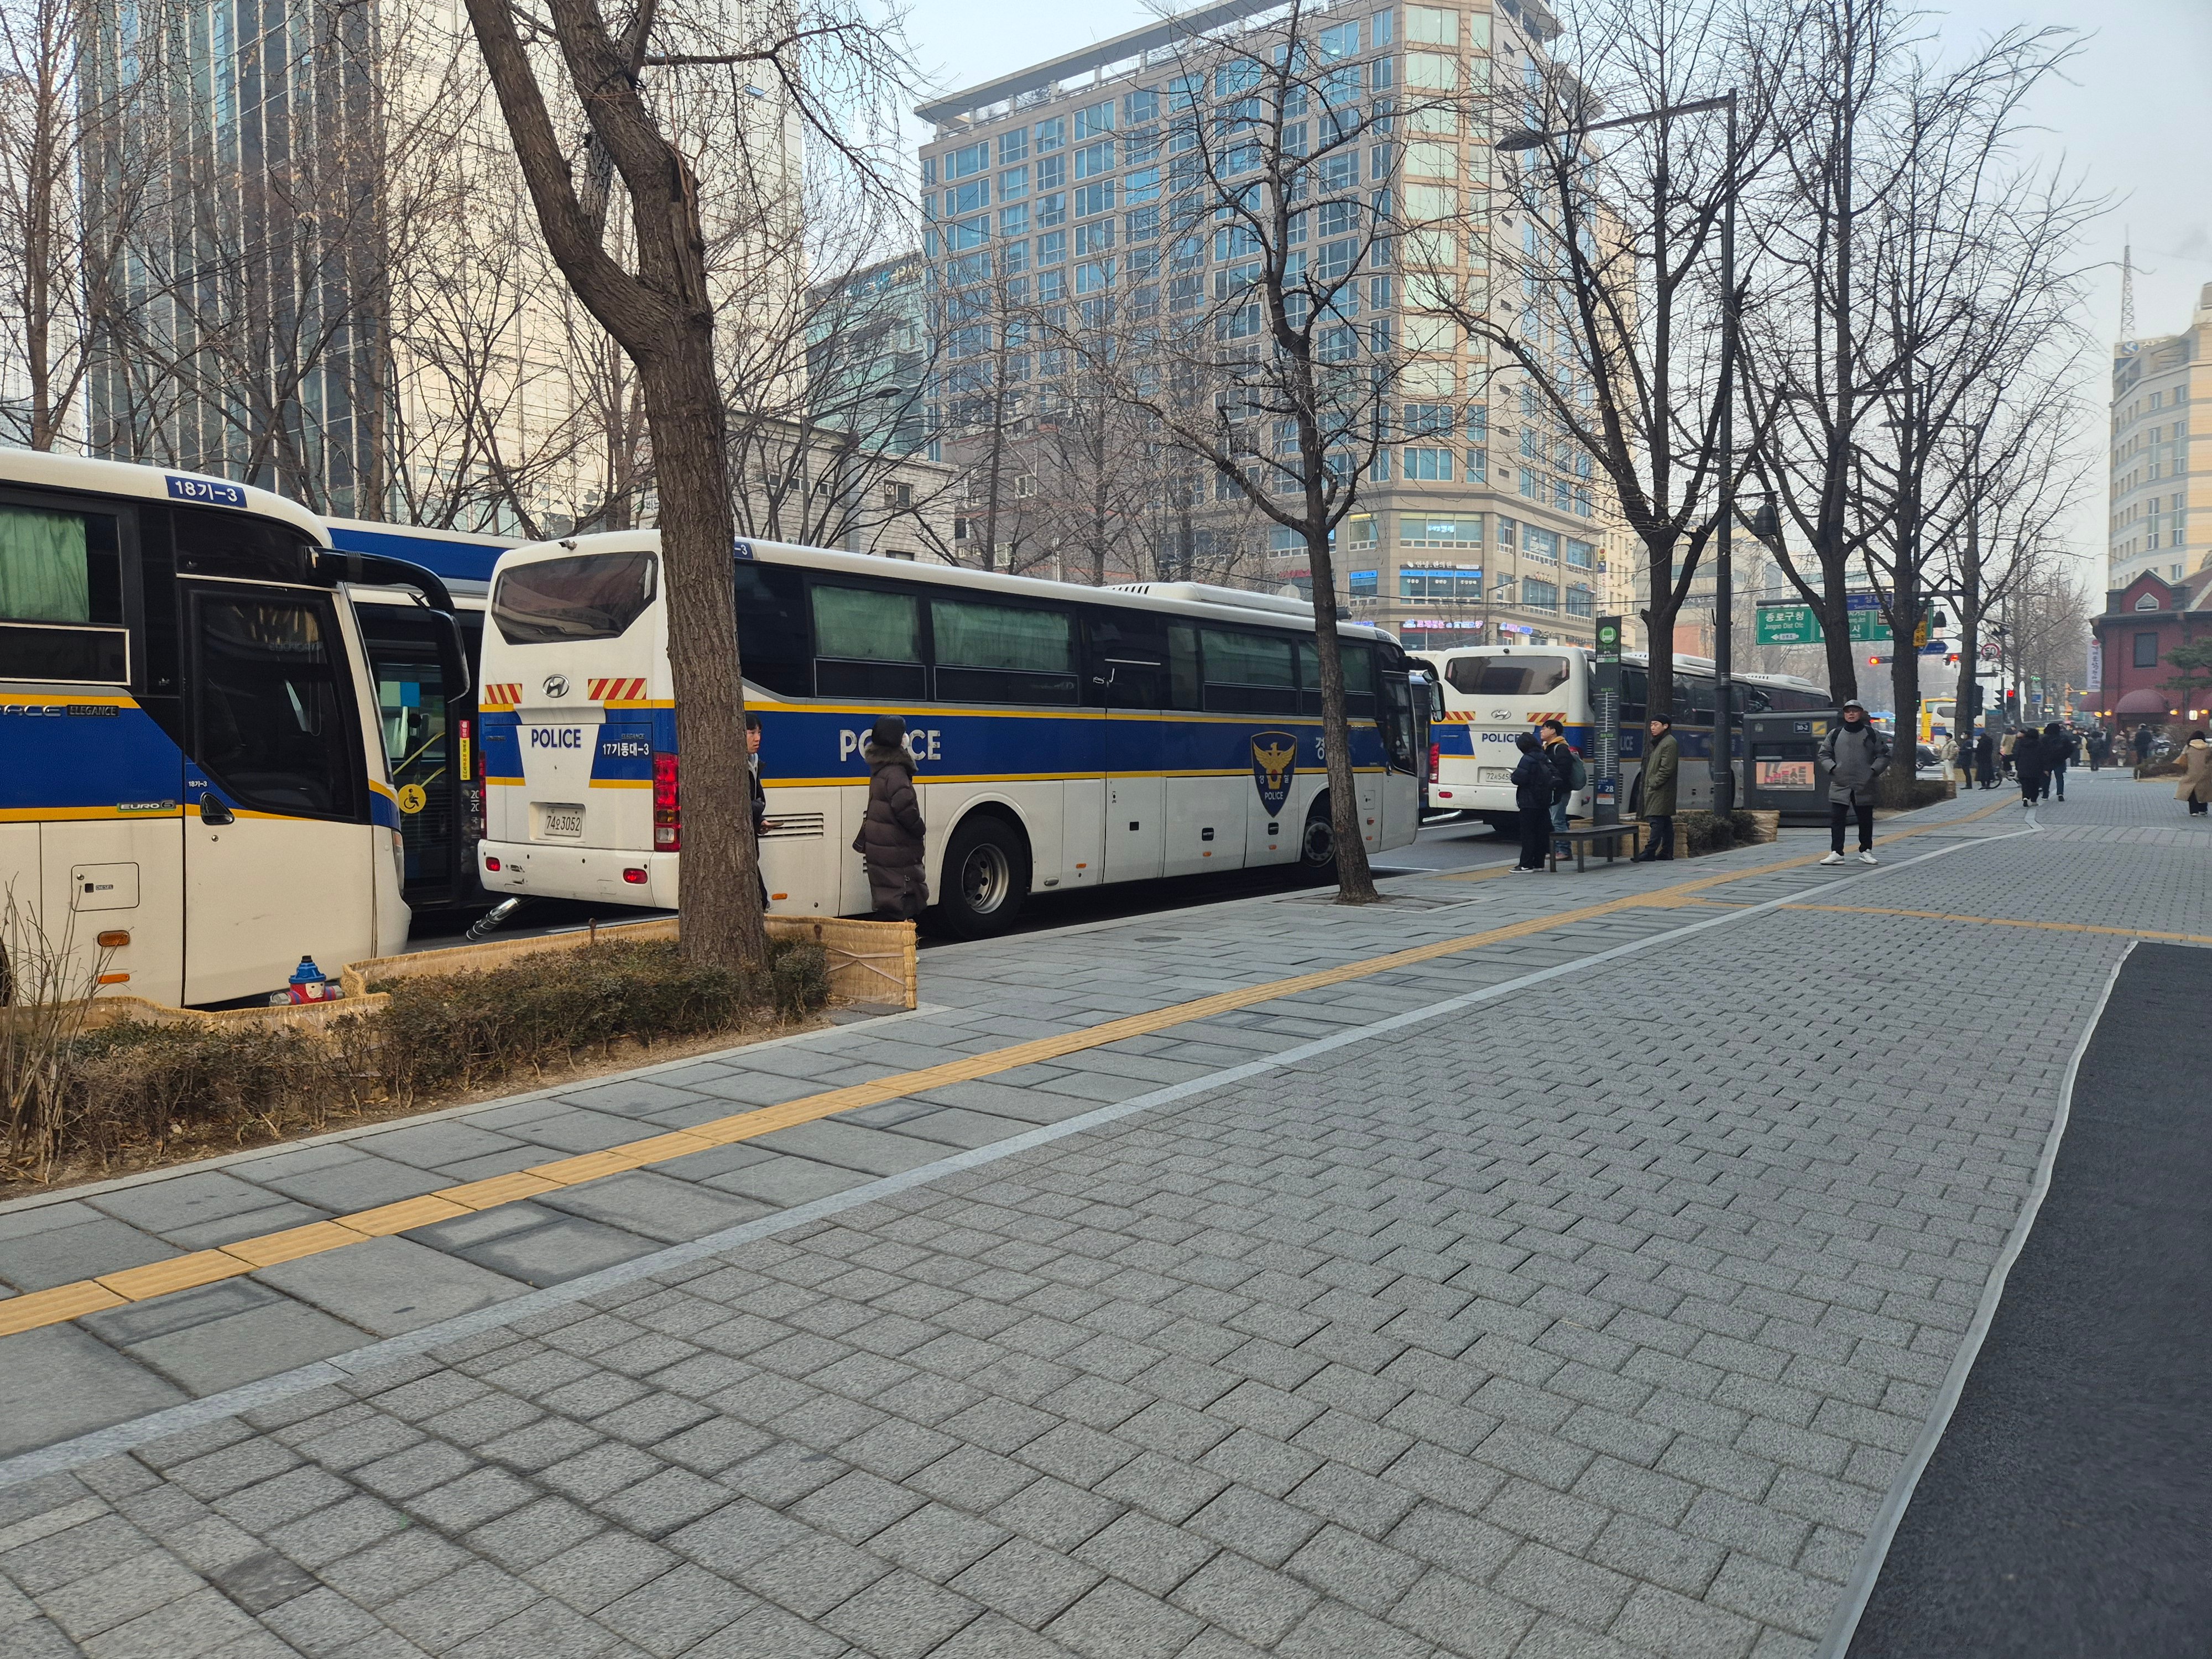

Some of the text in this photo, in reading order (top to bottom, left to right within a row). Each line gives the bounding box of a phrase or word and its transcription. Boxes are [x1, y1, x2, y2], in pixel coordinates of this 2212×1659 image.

[175, 481, 238, 502] 18기-3
[1765, 611, 1804, 622] 종로구청
[0, 704, 116, 717] ACE ELEGANCE
[531, 729, 581, 748] POLICE
[602, 742, 650, 757] 17기동대-3
[1265, 791, 1284, 801] POLICE
[546, 815, 581, 831] 74오3052
